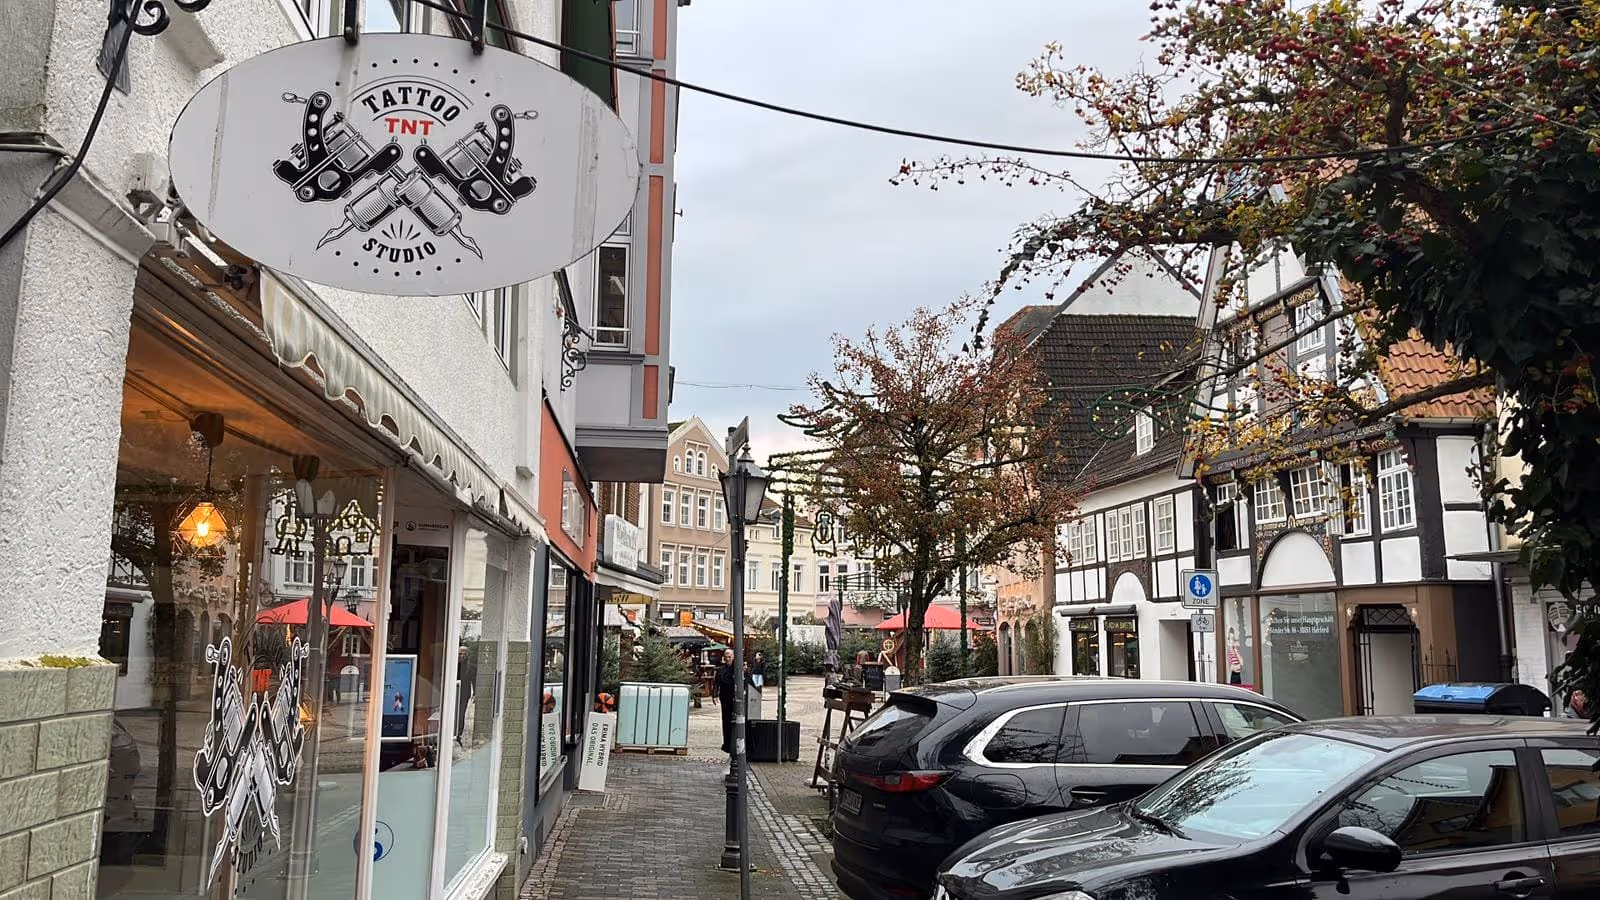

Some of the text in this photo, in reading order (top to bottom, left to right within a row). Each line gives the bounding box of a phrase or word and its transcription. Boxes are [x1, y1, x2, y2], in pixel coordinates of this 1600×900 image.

[361, 86, 461, 122] TATTOO
[384, 117, 434, 136] TNT
[362, 237, 437, 264] STUDIO
[251, 669, 273, 689] TNT
[598, 744, 606, 767] HYBRID
[232, 834, 263, 874] STUDIO
